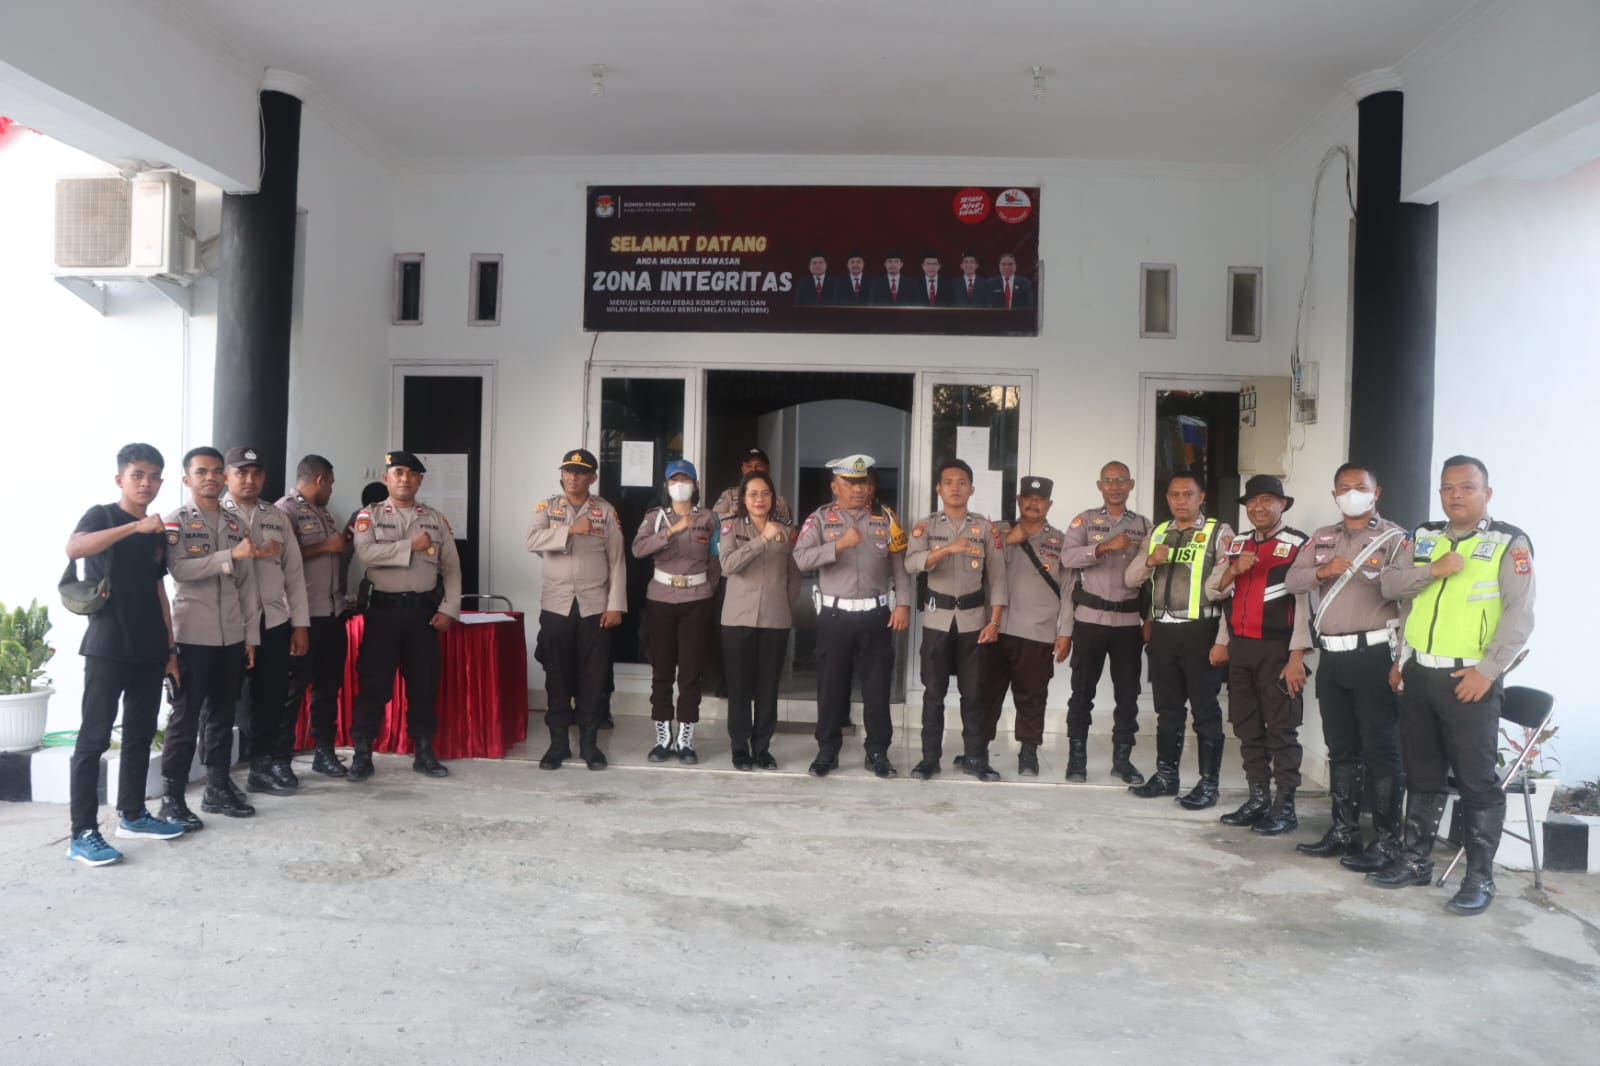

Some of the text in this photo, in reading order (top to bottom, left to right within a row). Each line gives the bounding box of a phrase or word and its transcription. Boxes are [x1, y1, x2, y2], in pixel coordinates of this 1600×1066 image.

[610, 236, 767, 252] SELAMAT DATANG
[636, 257, 740, 265] ANDA MEMASUKI KAWASAN
[592, 271, 793, 292] ZONA INTEGRITAS
[1177, 549, 1197, 562] ISI
